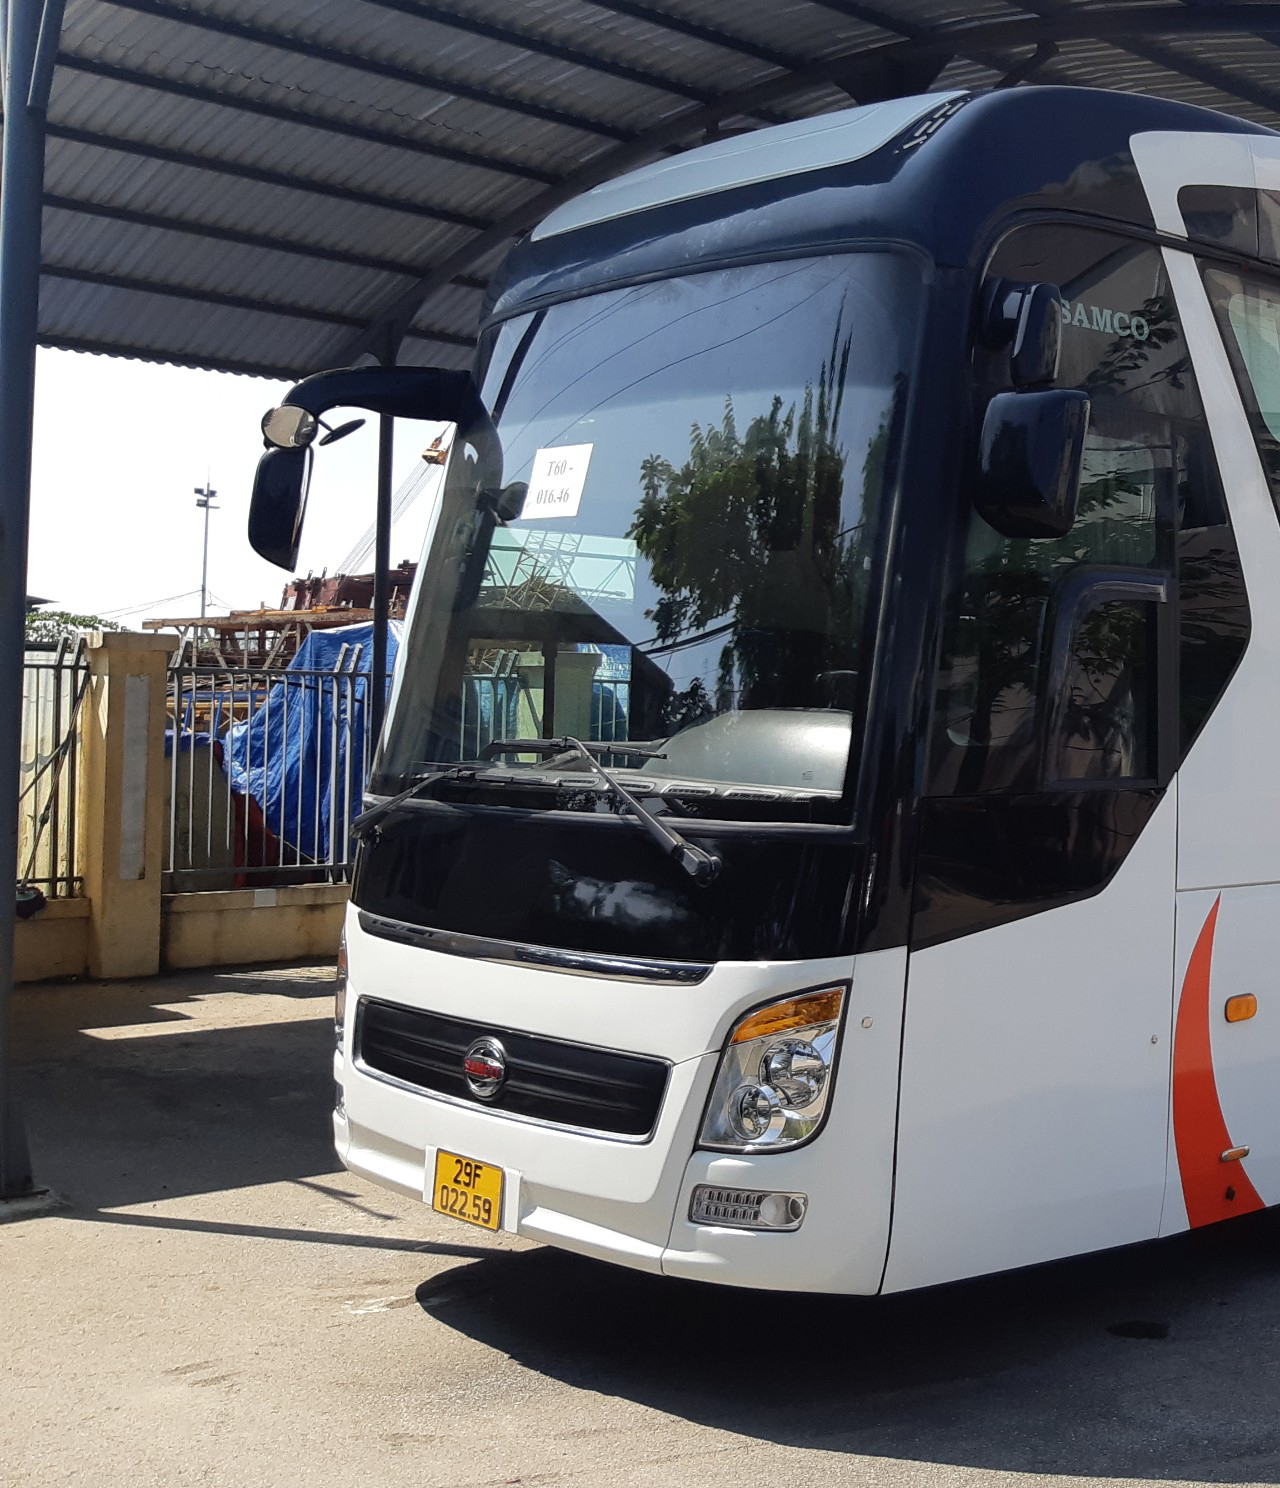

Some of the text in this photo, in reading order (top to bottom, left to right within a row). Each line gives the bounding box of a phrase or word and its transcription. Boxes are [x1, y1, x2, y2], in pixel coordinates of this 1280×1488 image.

[1060, 299, 1150, 341] SAMCO
[536, 487, 570, 504] 016.46
[453, 1158, 483, 1190] 29F
[440, 1185, 492, 1224] 022.59
